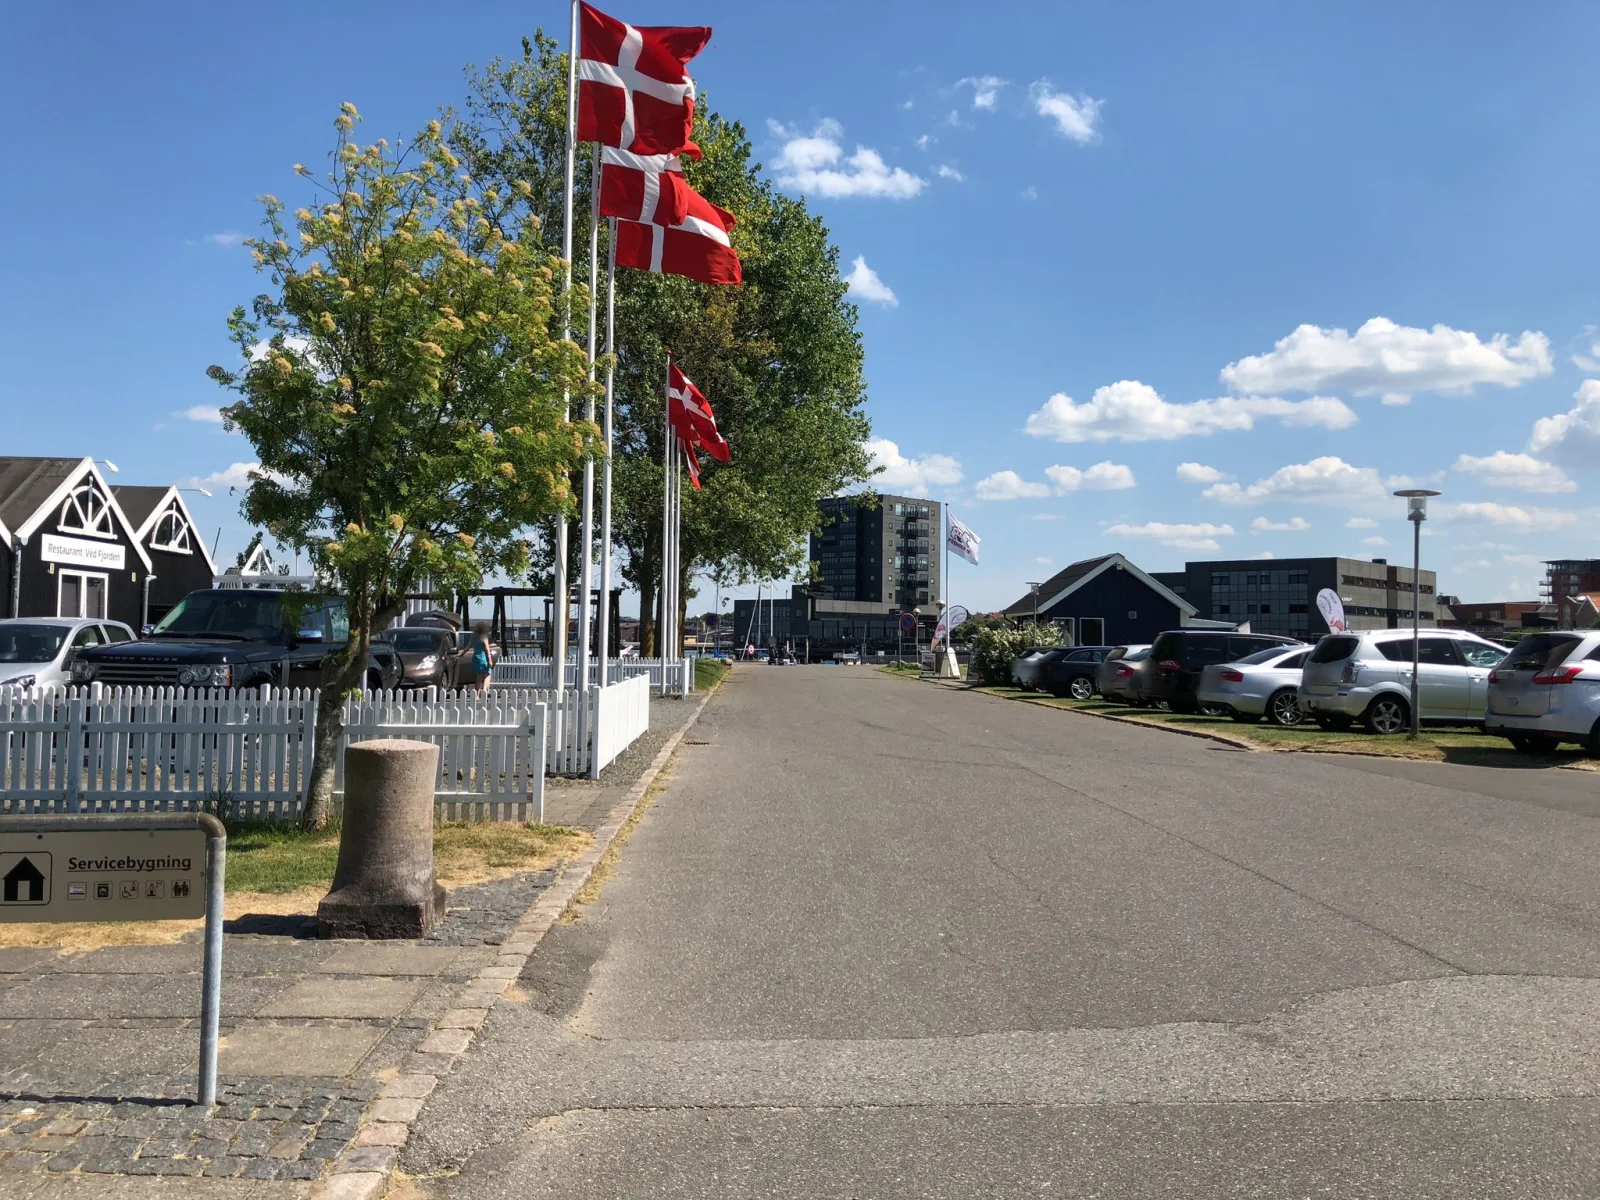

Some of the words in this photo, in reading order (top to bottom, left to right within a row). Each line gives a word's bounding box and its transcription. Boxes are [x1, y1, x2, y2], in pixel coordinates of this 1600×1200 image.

[48, 543, 83, 557] Restaurant
[85, 548, 97, 559] Ved
[98, 549, 120, 562] Fjorden
[68, 855, 192, 872] Servicebygning
